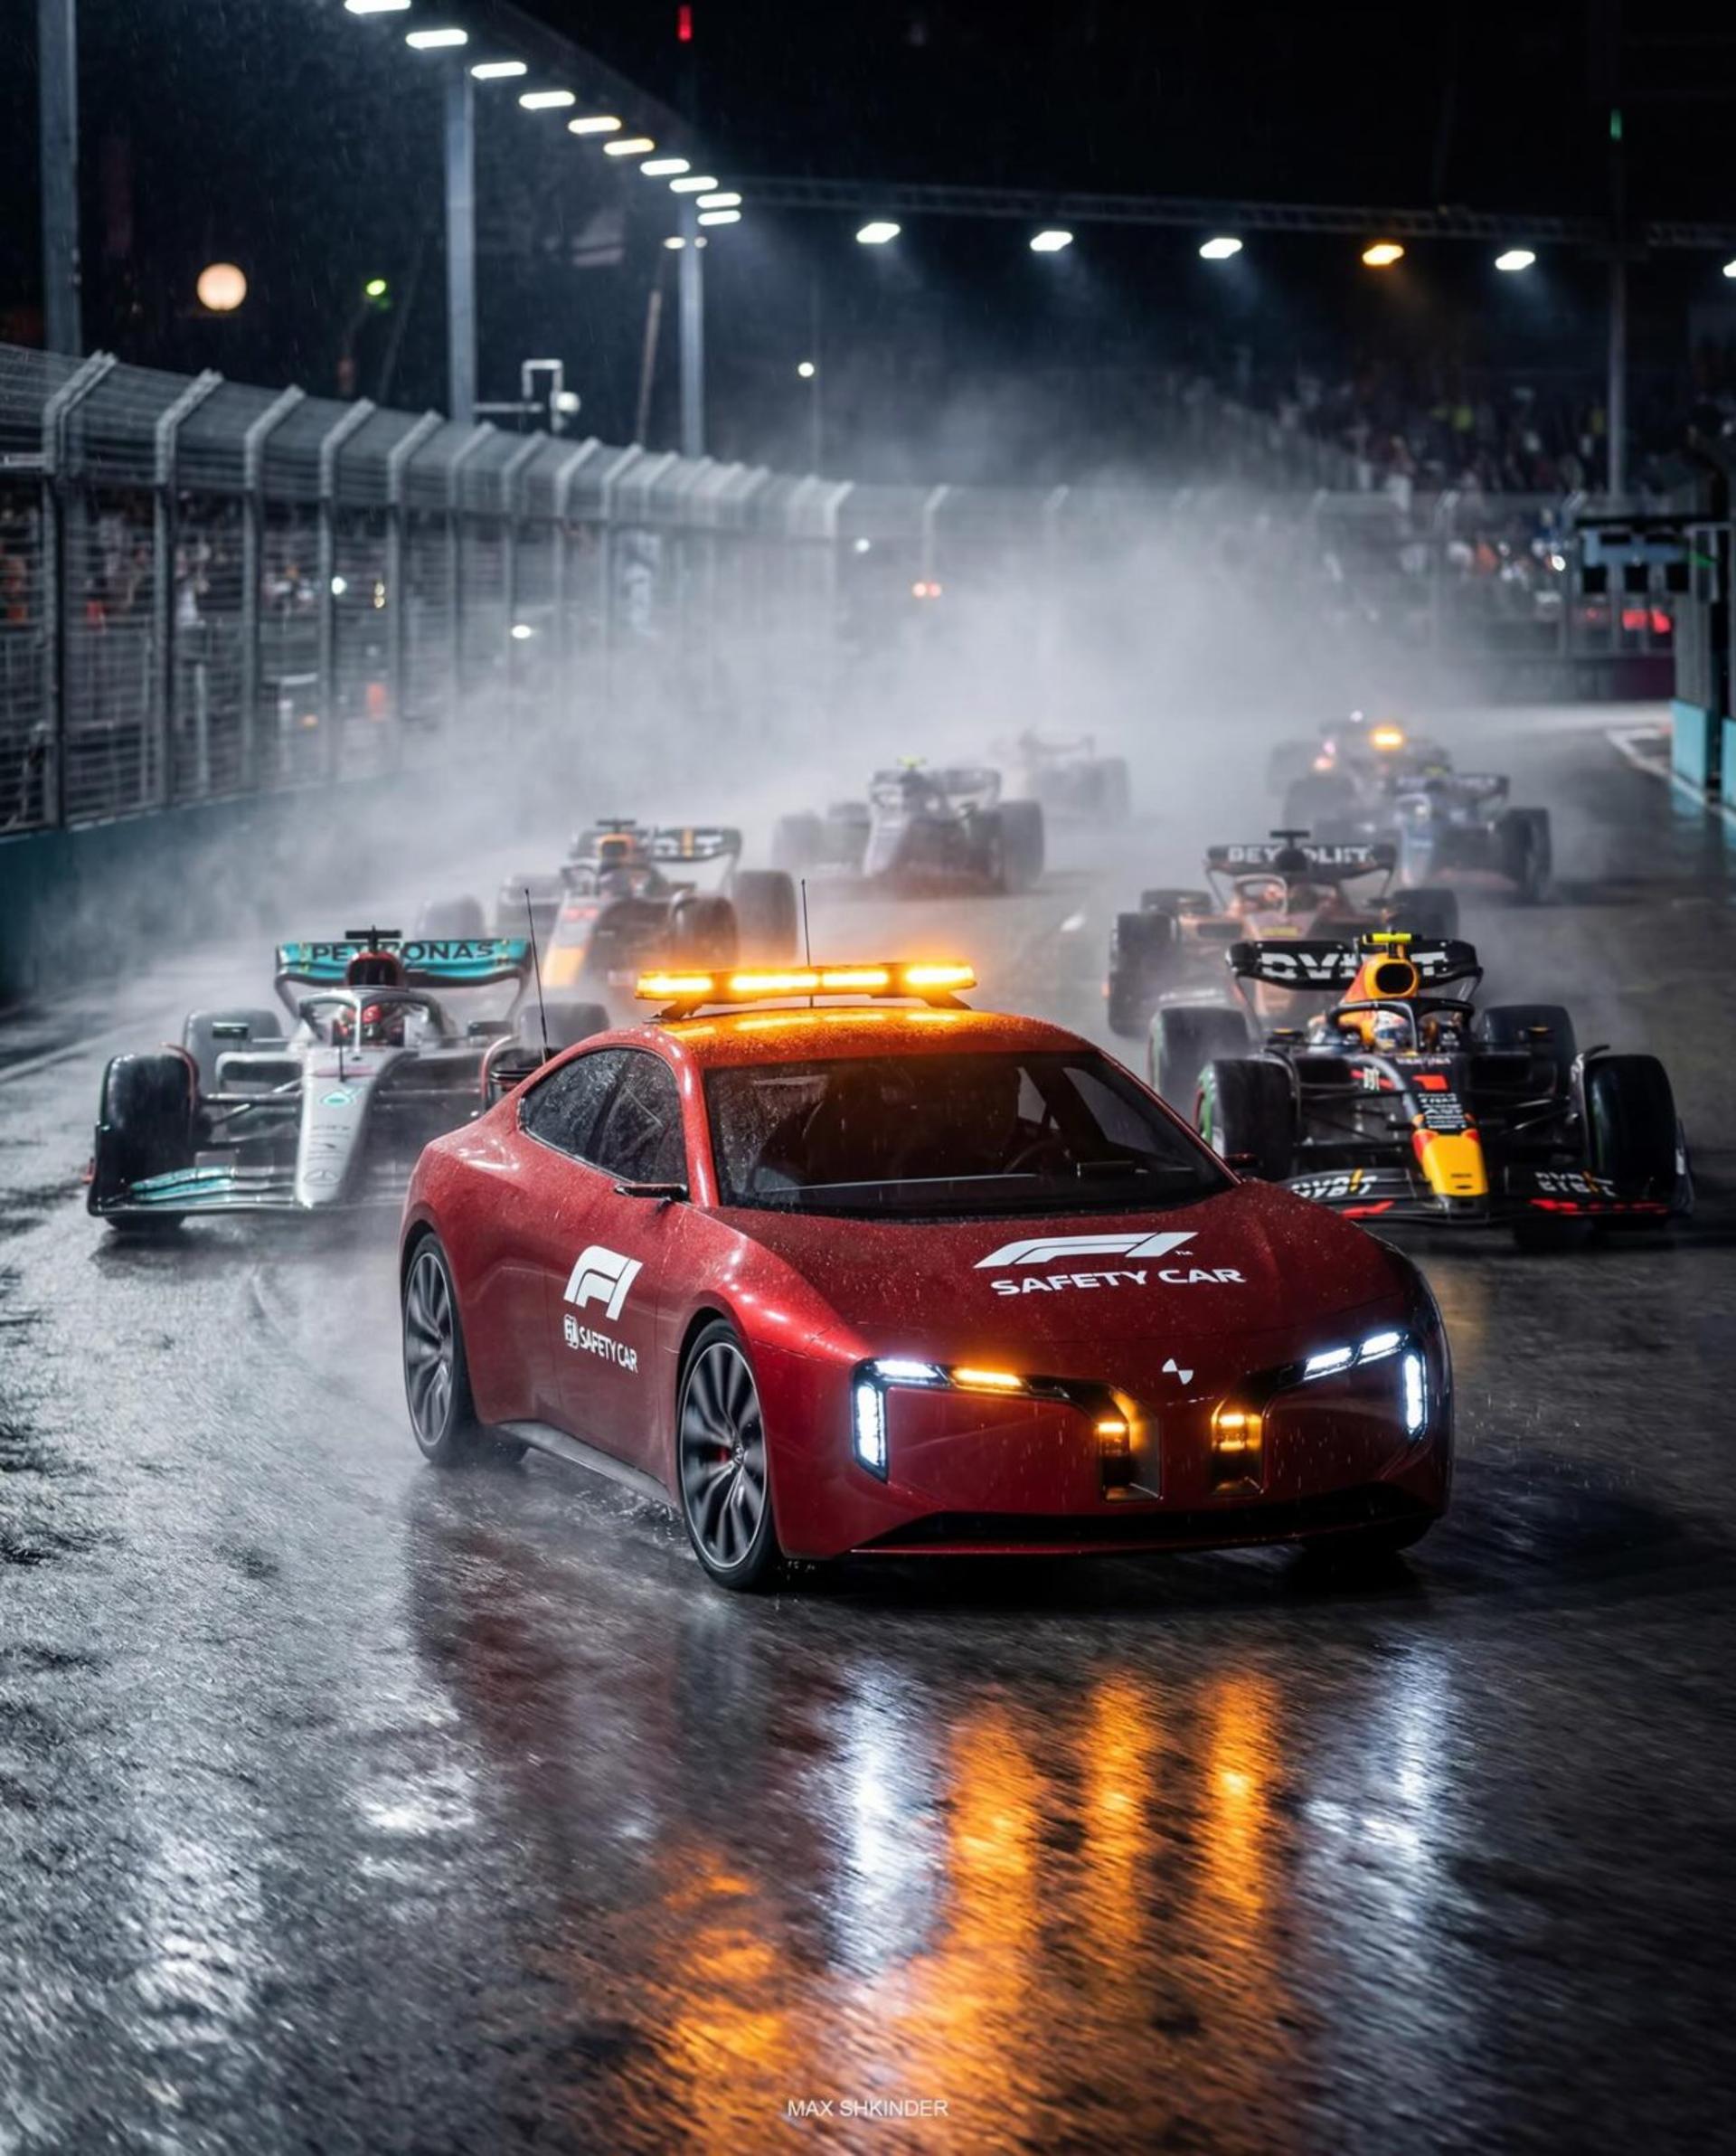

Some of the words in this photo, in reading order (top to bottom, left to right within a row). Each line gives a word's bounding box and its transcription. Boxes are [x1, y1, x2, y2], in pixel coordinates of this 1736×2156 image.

[311, 941, 495, 962] PEONAS
[990, 1271, 1147, 1296] SAFETY
[1158, 1269, 1247, 1283] CAR
[579, 1326, 617, 1363] SAFETY
[617, 1343, 638, 1374] CAR
